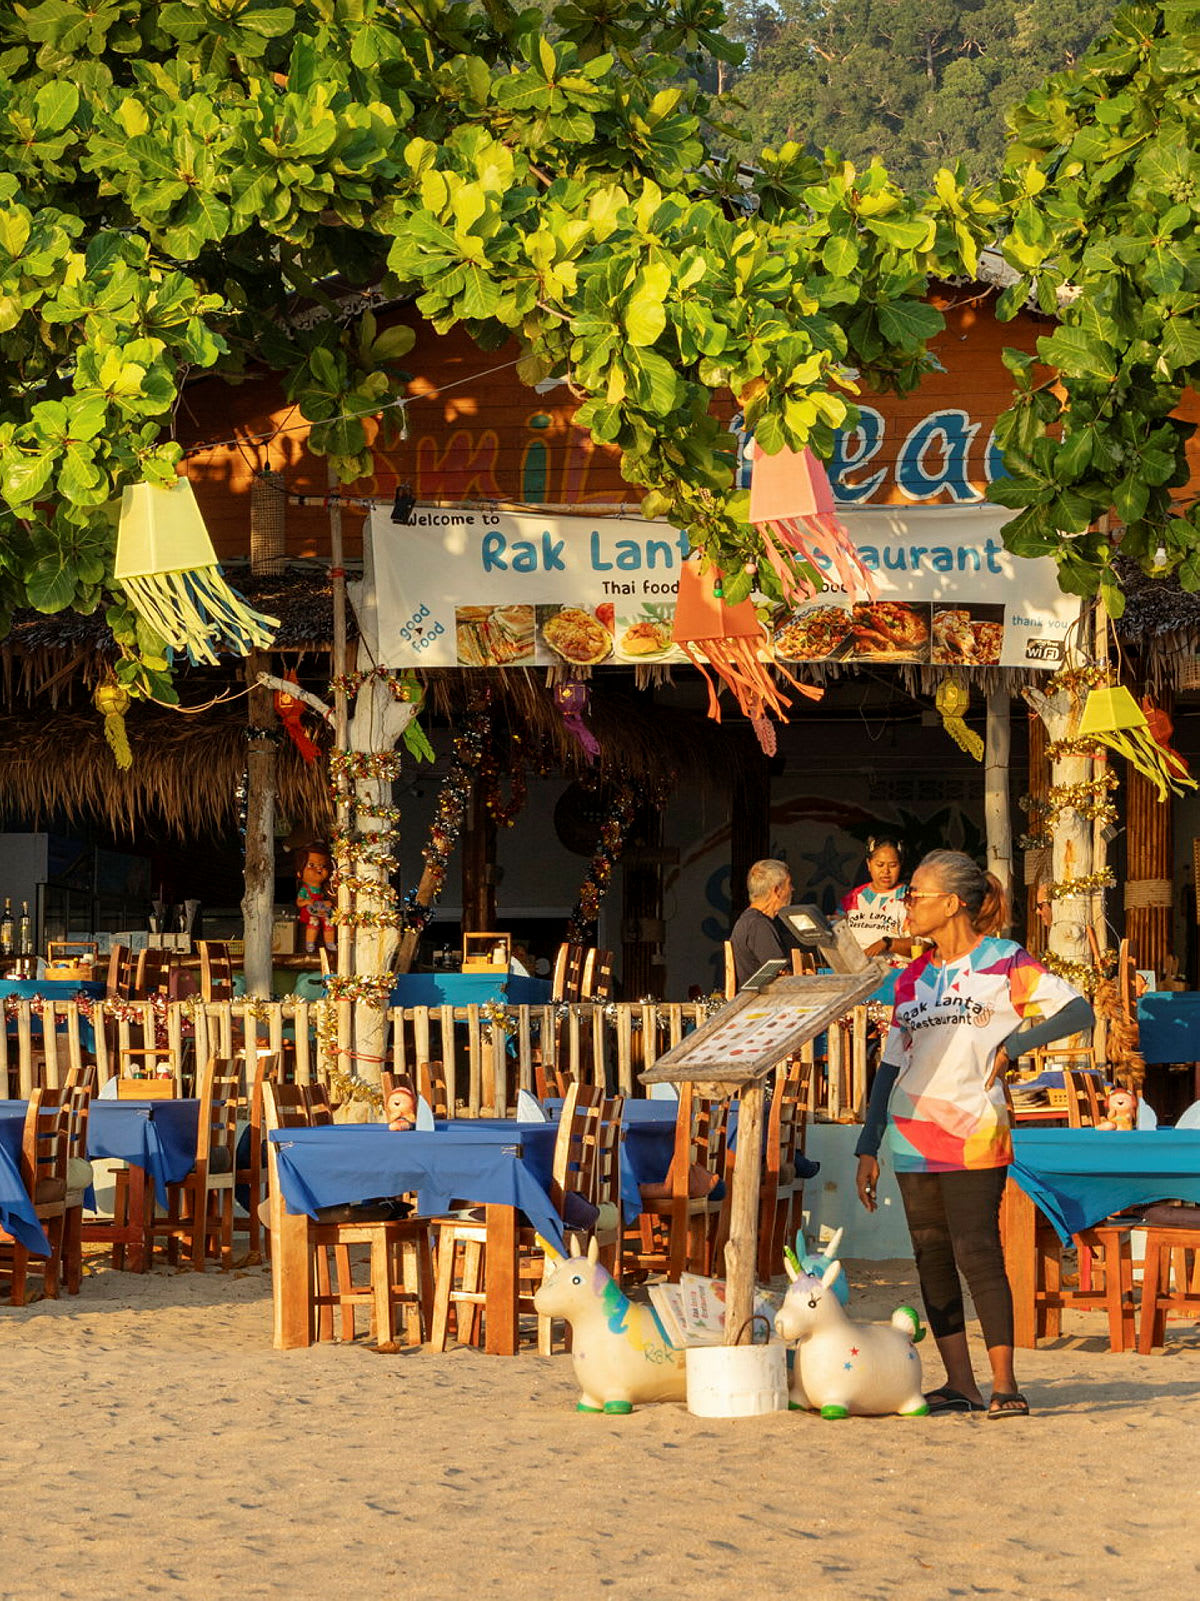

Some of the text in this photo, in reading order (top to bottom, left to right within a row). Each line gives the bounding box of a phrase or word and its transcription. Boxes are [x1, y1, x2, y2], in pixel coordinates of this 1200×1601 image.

[482, 514, 501, 526] to
[481, 529, 1004, 575] Rak Lant saurant
[602, 580, 636, 595] Thai
[642, 579, 680, 595] food
[400, 603, 431, 641] good
[1011, 614, 1069, 629] thank you
[910, 1013, 973, 1032] Restaurant
